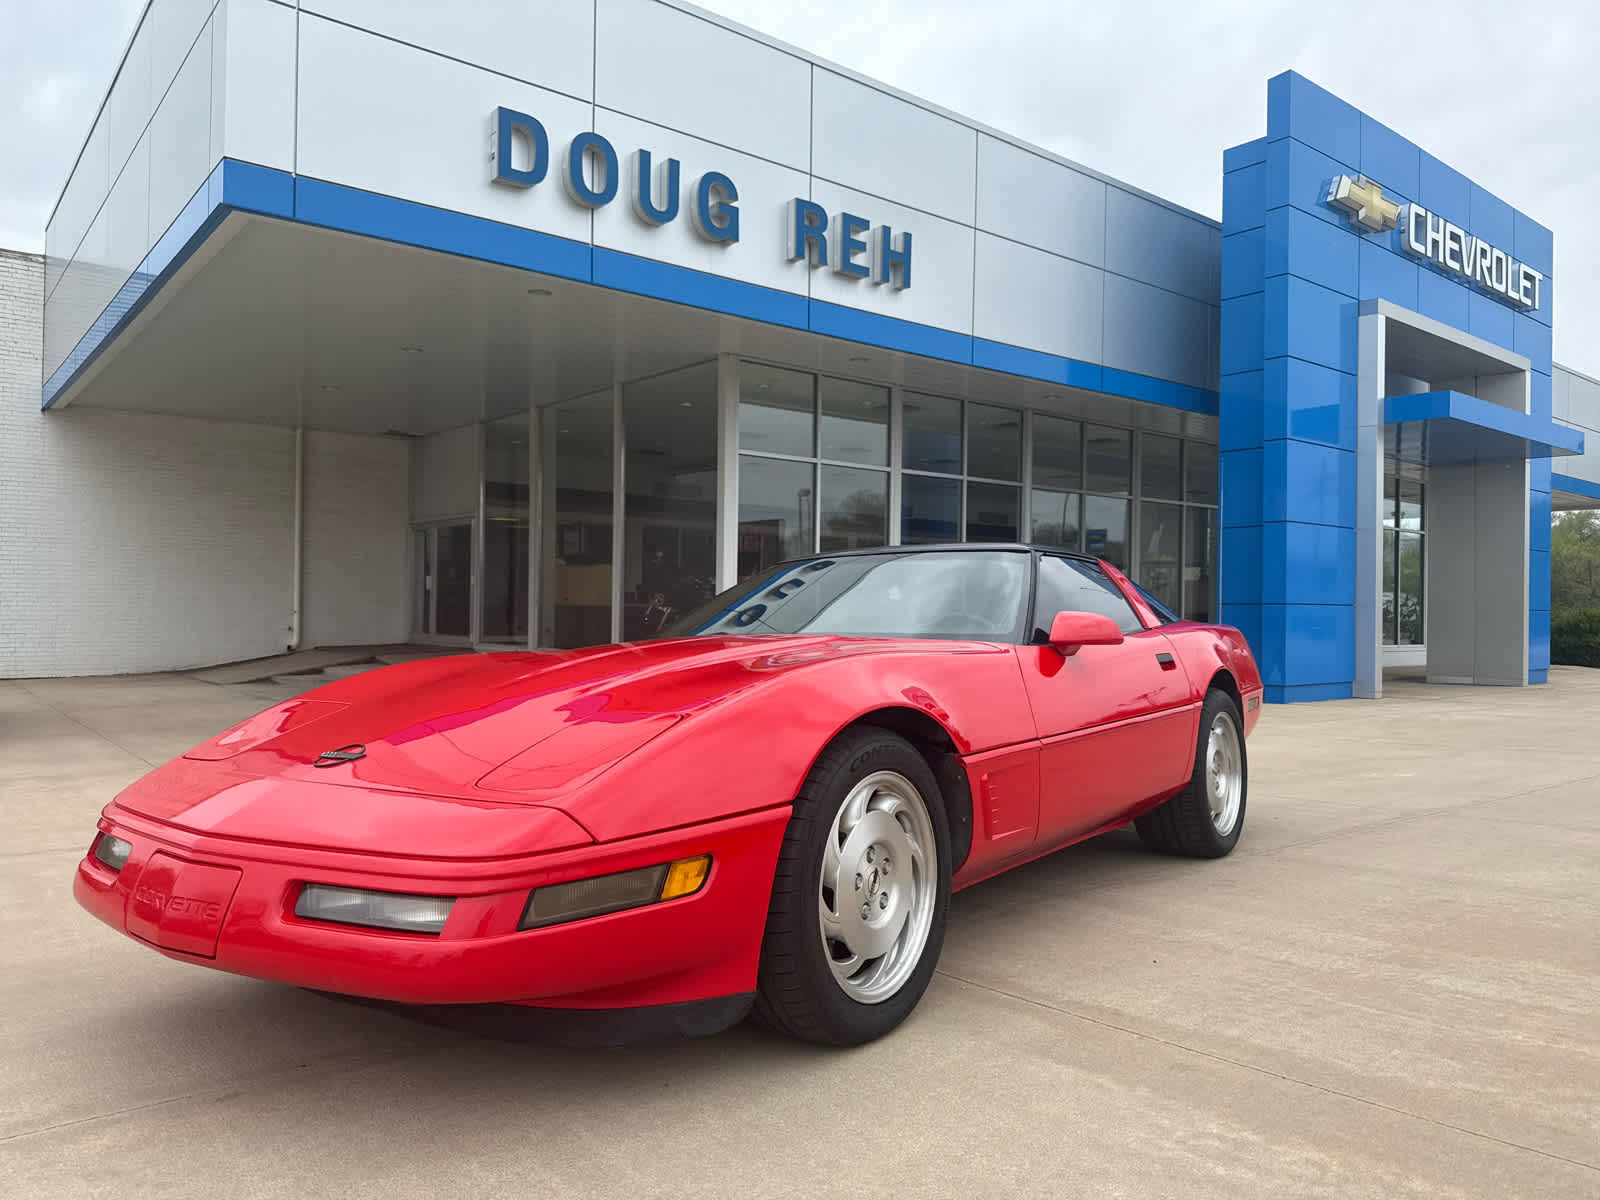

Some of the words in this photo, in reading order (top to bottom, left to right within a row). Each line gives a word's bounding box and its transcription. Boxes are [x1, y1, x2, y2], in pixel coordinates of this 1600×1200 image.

[496, 106, 740, 243] DOUG
[792, 198, 912, 289] REH
[1408, 203, 1543, 310] CHEVROLET
